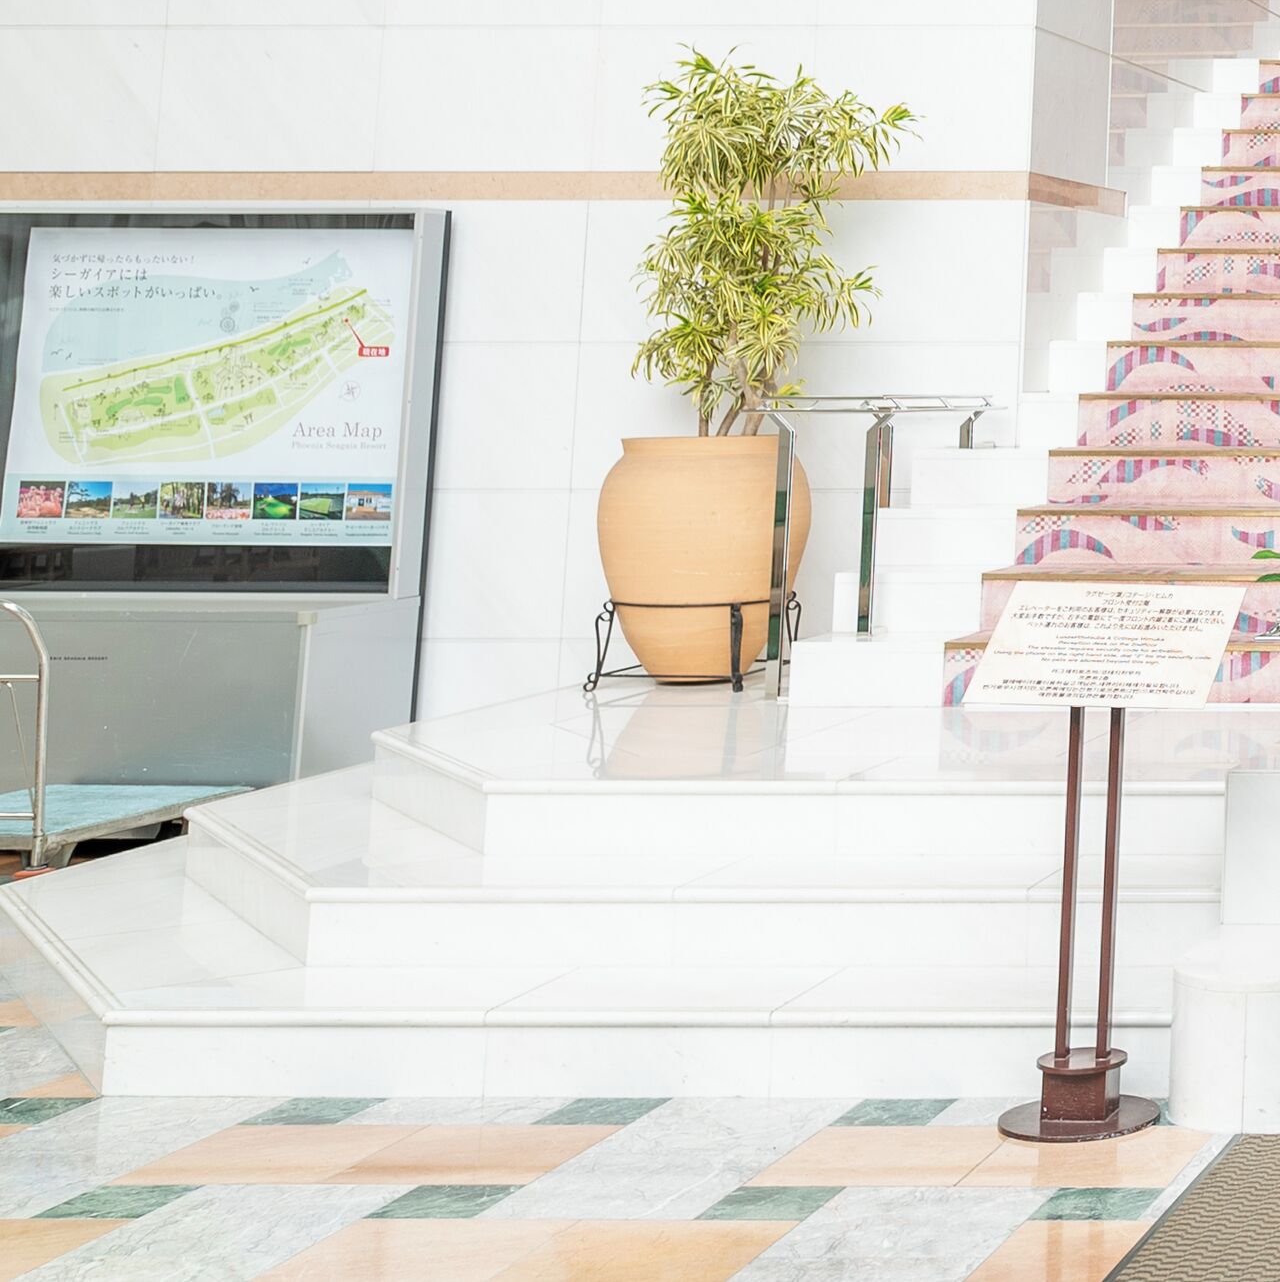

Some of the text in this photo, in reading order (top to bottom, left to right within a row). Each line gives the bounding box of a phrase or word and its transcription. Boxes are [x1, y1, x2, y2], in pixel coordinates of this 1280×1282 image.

[51, 268, 148, 281] シーガイアには
[49, 285, 223, 300] 楽しいスポットがいっぱい。
[362, 347, 386, 357] 現在地
[292, 421, 383, 442] Area Map
